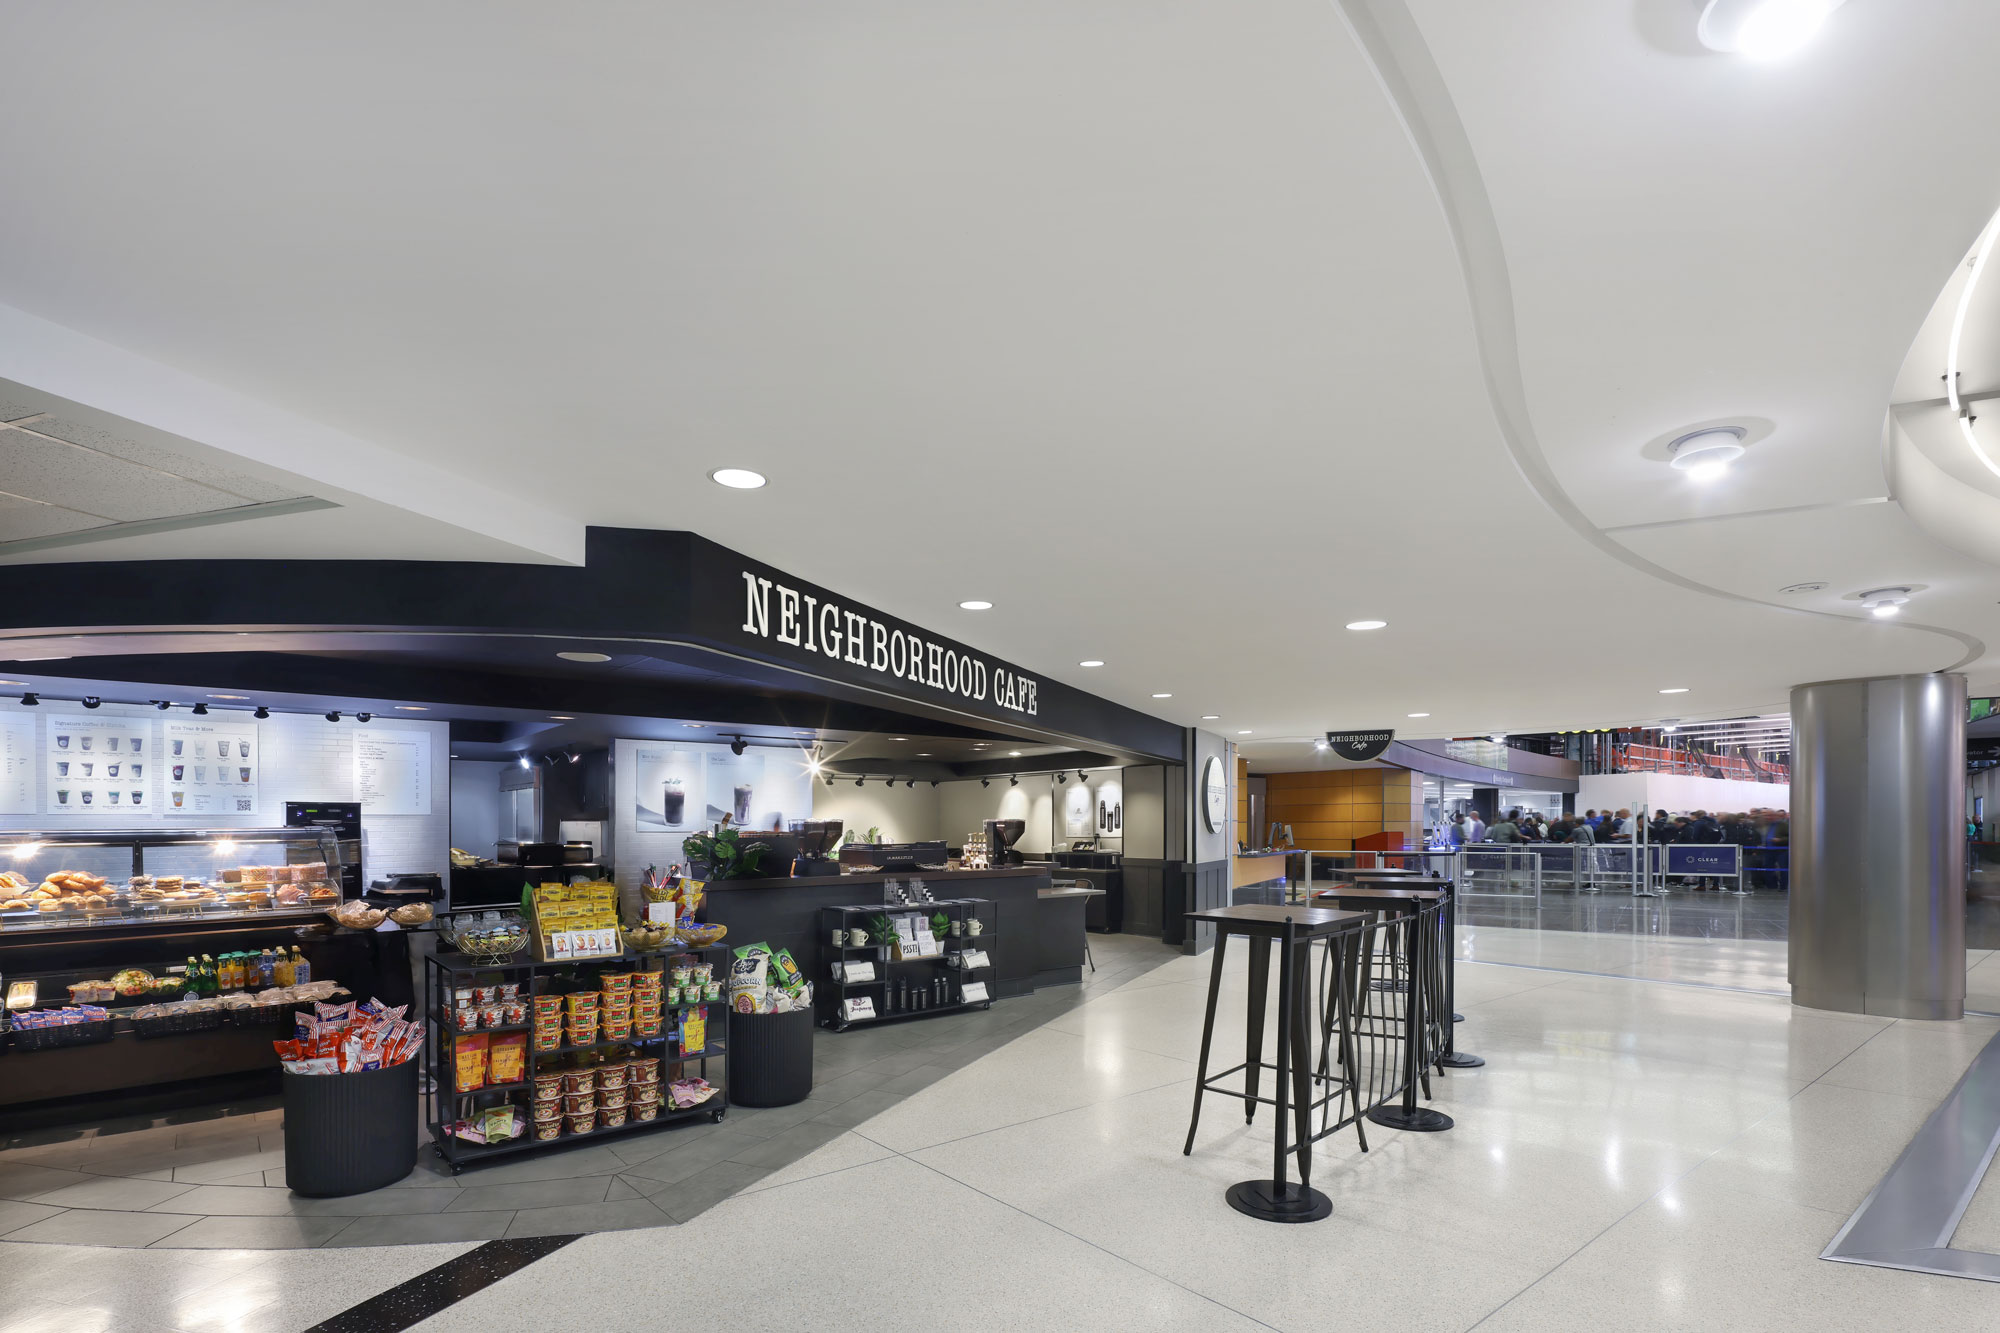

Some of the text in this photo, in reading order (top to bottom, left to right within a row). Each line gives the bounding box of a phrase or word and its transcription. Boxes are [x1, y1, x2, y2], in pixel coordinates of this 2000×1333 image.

[742, 571, 1037, 715] NEIGHBORHOOD CAFE
[1331, 734, 1390, 742] NEIGHBORHOOD
[903, 944, 918, 954] PSST!
[733, 977, 762, 987] OPCORN
